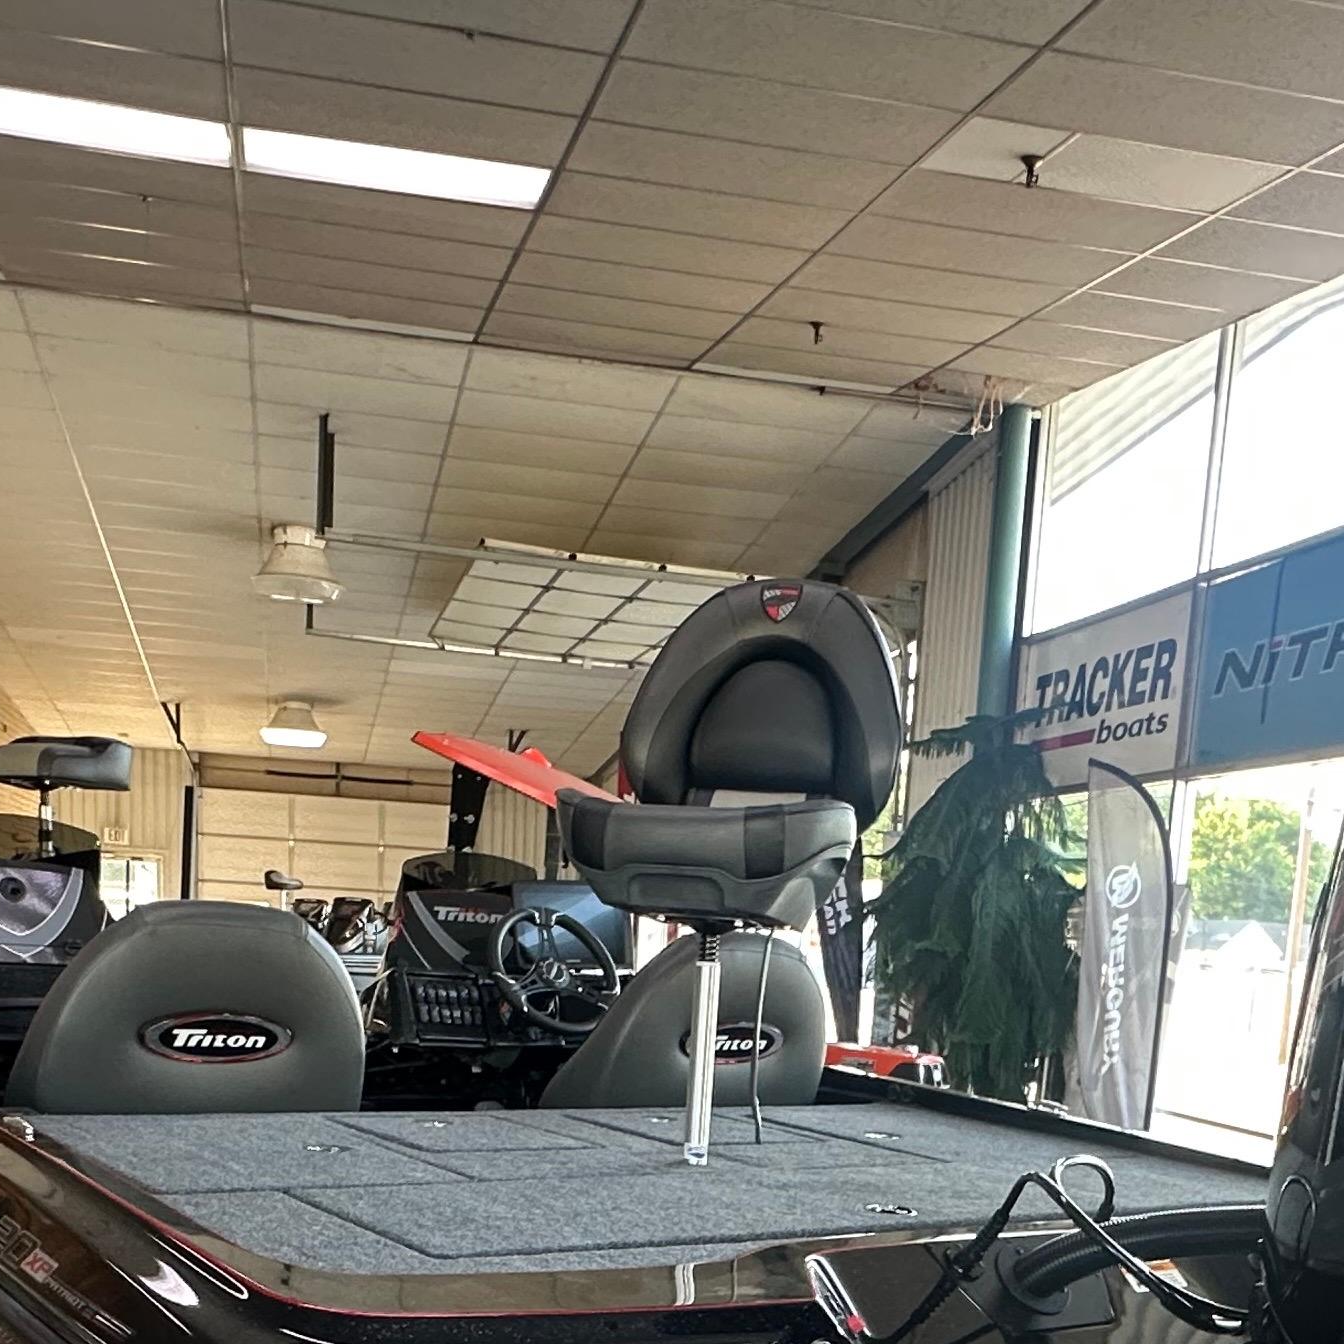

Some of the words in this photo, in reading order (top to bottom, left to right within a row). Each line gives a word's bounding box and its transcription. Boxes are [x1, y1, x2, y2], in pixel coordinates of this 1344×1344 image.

[1035, 638, 1177, 728] TRACKER
[1096, 712, 1169, 744] boats
[434, 905, 505, 924] Triton
[171, 1028, 267, 1049] Triton
